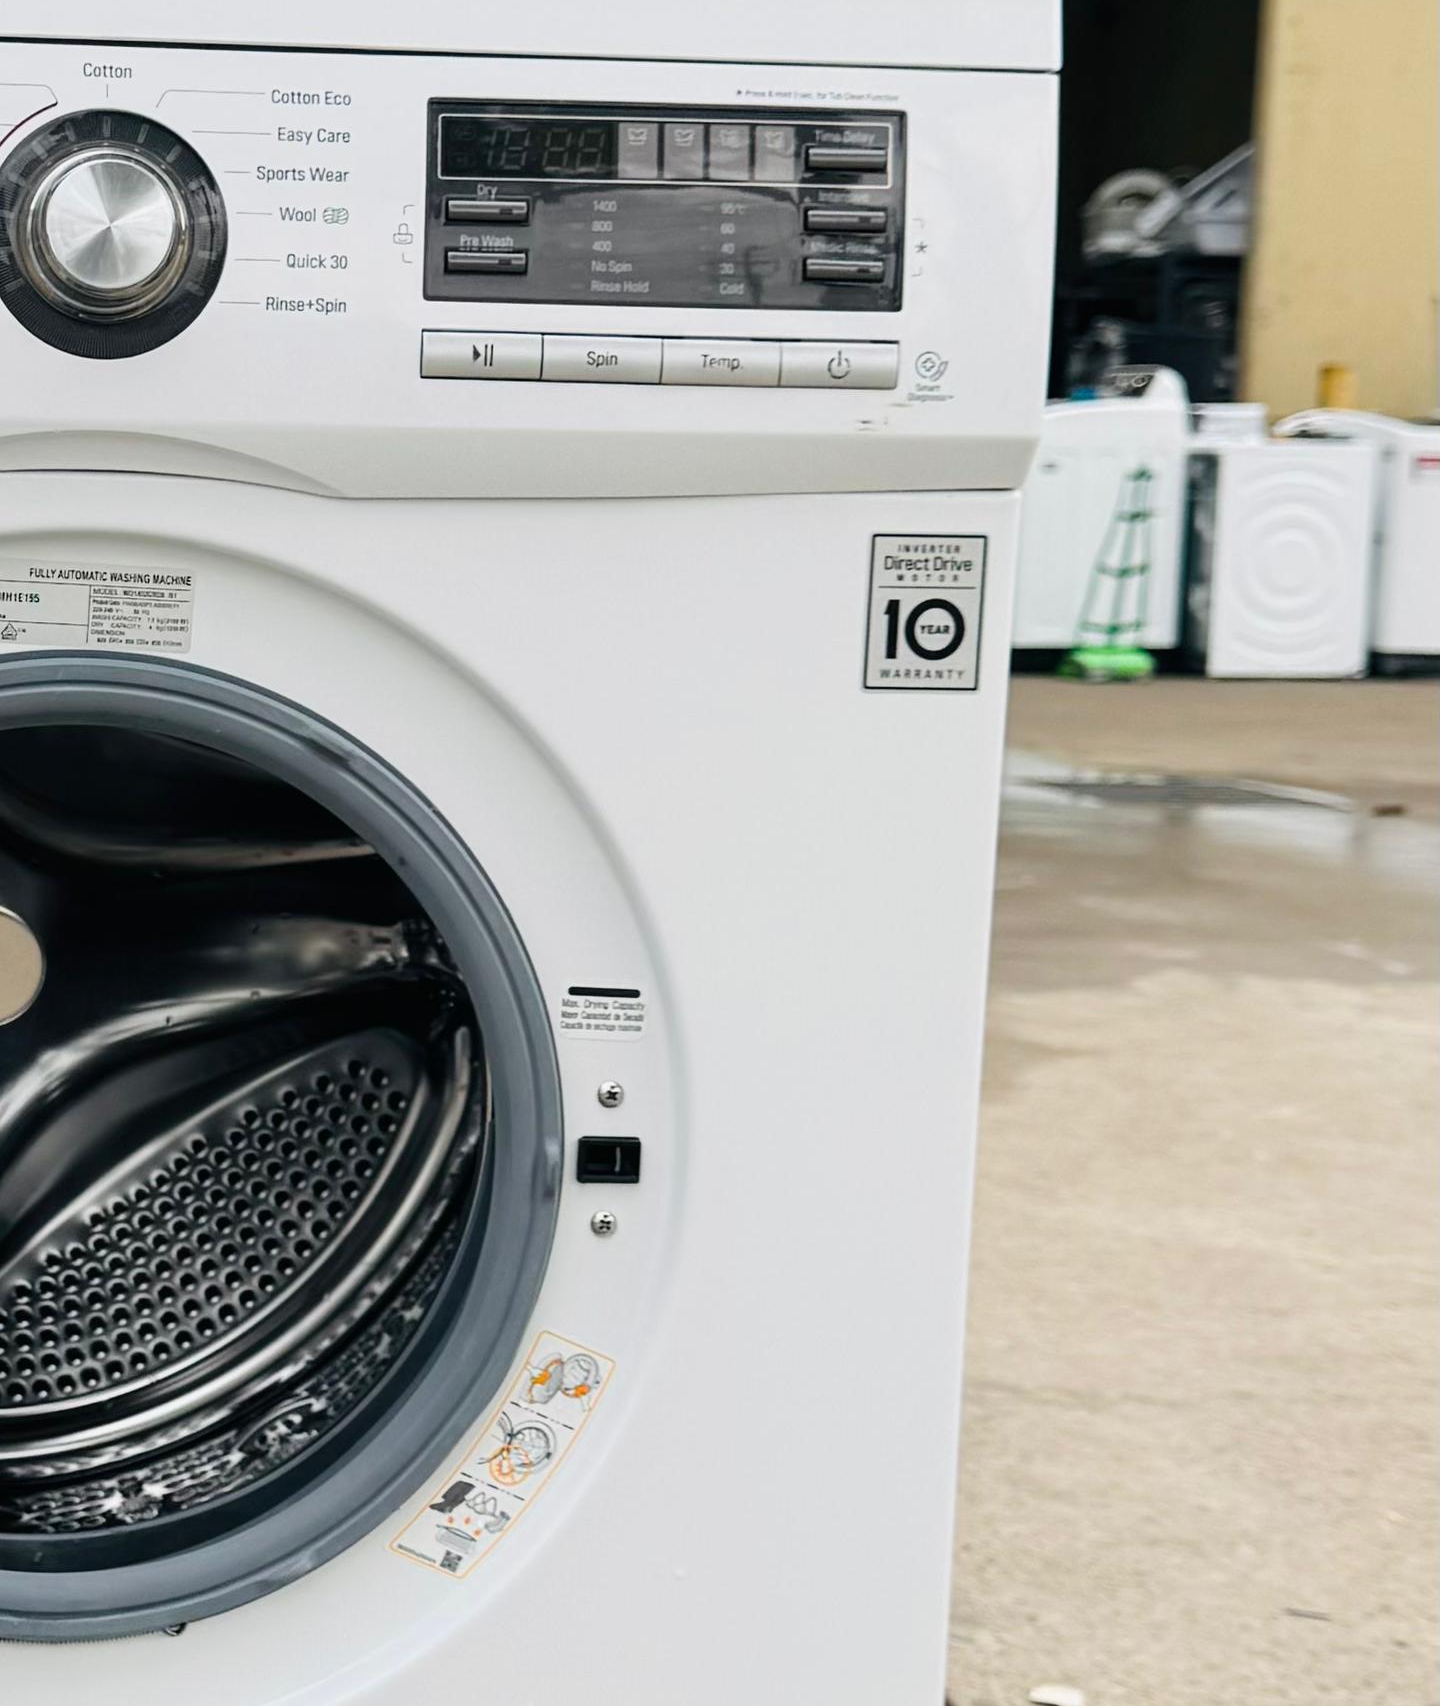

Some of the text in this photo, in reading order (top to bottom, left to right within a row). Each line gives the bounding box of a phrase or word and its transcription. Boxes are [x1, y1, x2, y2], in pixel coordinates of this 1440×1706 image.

[82, 62, 133, 80] Cotton
[271, 90, 352, 106] Cotton Eco
[277, 127, 351, 145] Easy Care
[257, 165, 350, 183] Sports Wear
[477, 184, 498, 198] Dry
[280, 207, 317, 222] Wool
[460, 235, 514, 248] Pre Wash
[286, 254, 348, 269] Quick 30
[591, 261, 632, 274] No Spin
[591, 280, 650, 293] Rinse Hold
[265, 296, 347, 315] Rinse+Spin
[586, 350, 619, 369] Spin
[701, 354, 744, 373] Temp.
[898, 544, 962, 555] INVERTER
[884, 555, 973, 572] Direct Drive
[29, 567, 192, 587] FULLY AUTOMATIC WASHING MACHINE
[884, 598, 965, 660] 10
[919, 624, 951, 635] YEAR
[879, 668, 965, 680] WARRANTY
